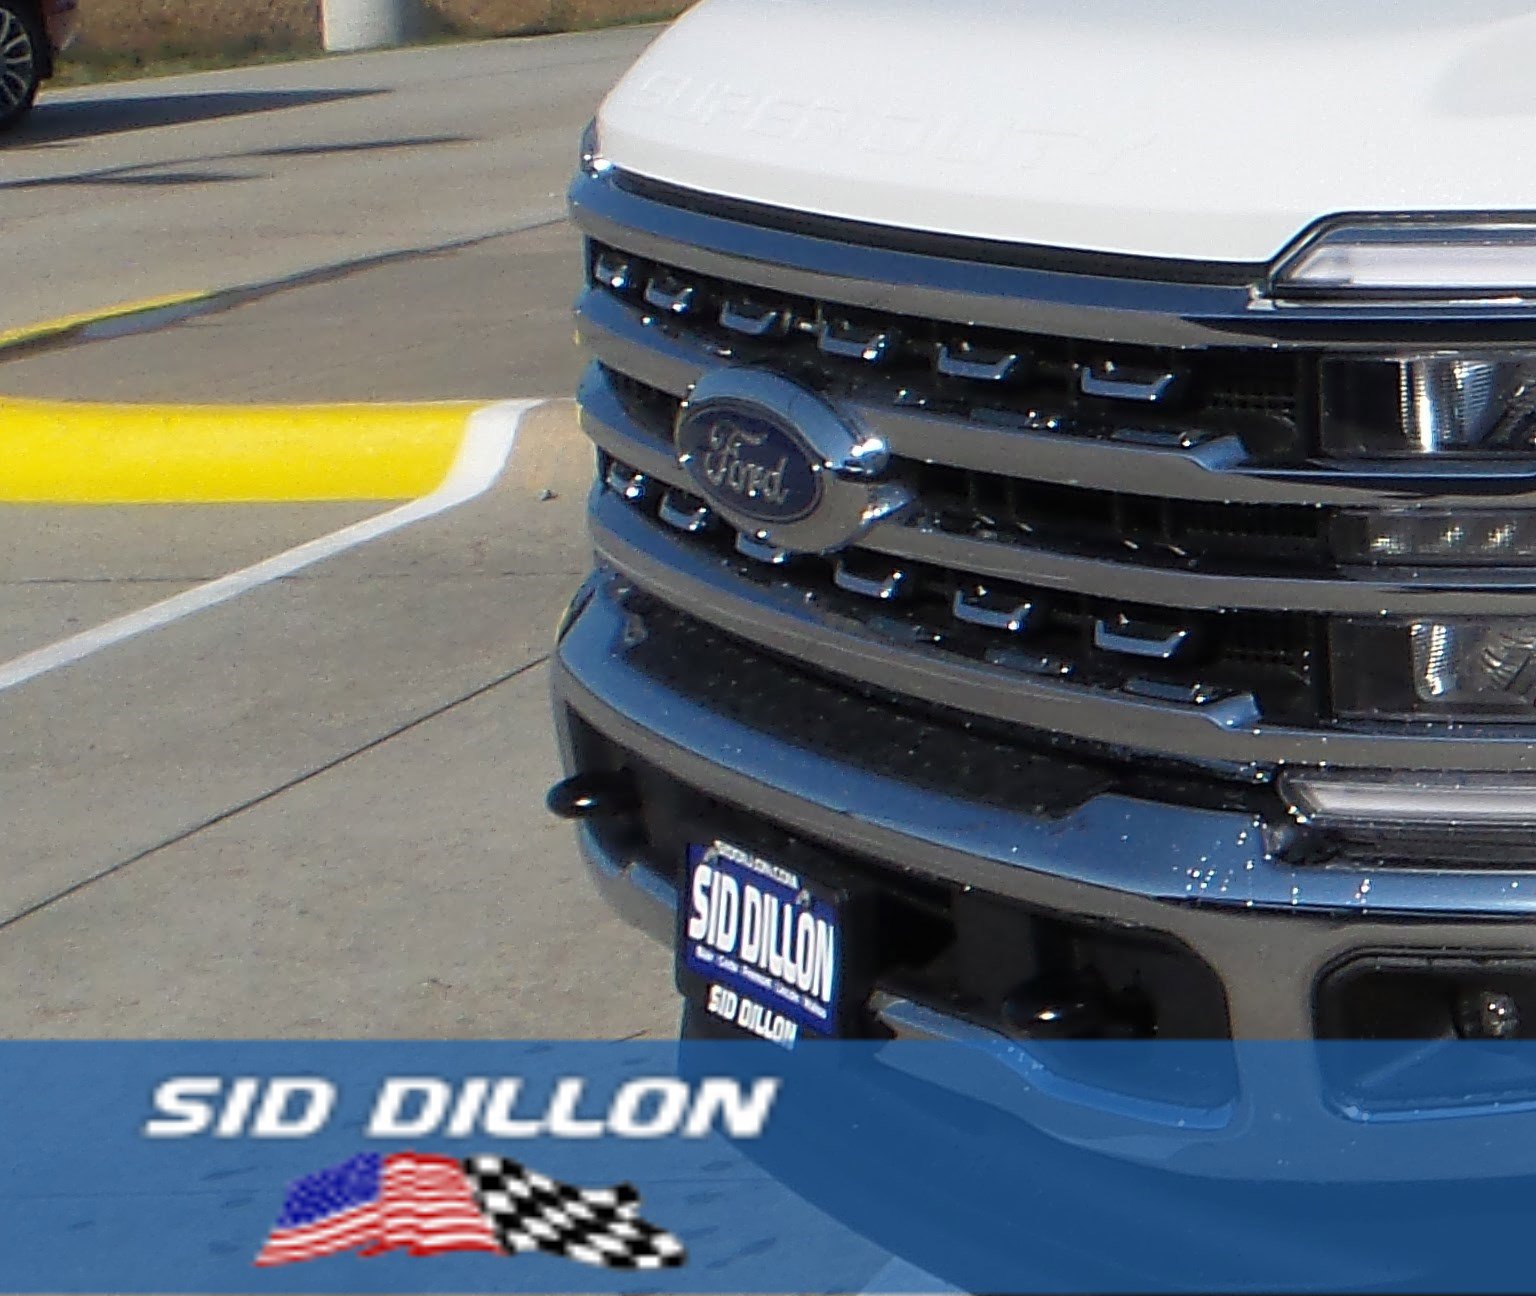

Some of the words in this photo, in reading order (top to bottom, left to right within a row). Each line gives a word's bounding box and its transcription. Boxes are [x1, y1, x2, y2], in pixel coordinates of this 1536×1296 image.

[704, 422, 789, 504] Ford
[688, 864, 739, 953] SID
[740, 884, 834, 1002] DILLON
[708, 983, 739, 1020] SID
[738, 998, 798, 1051] DILLON
